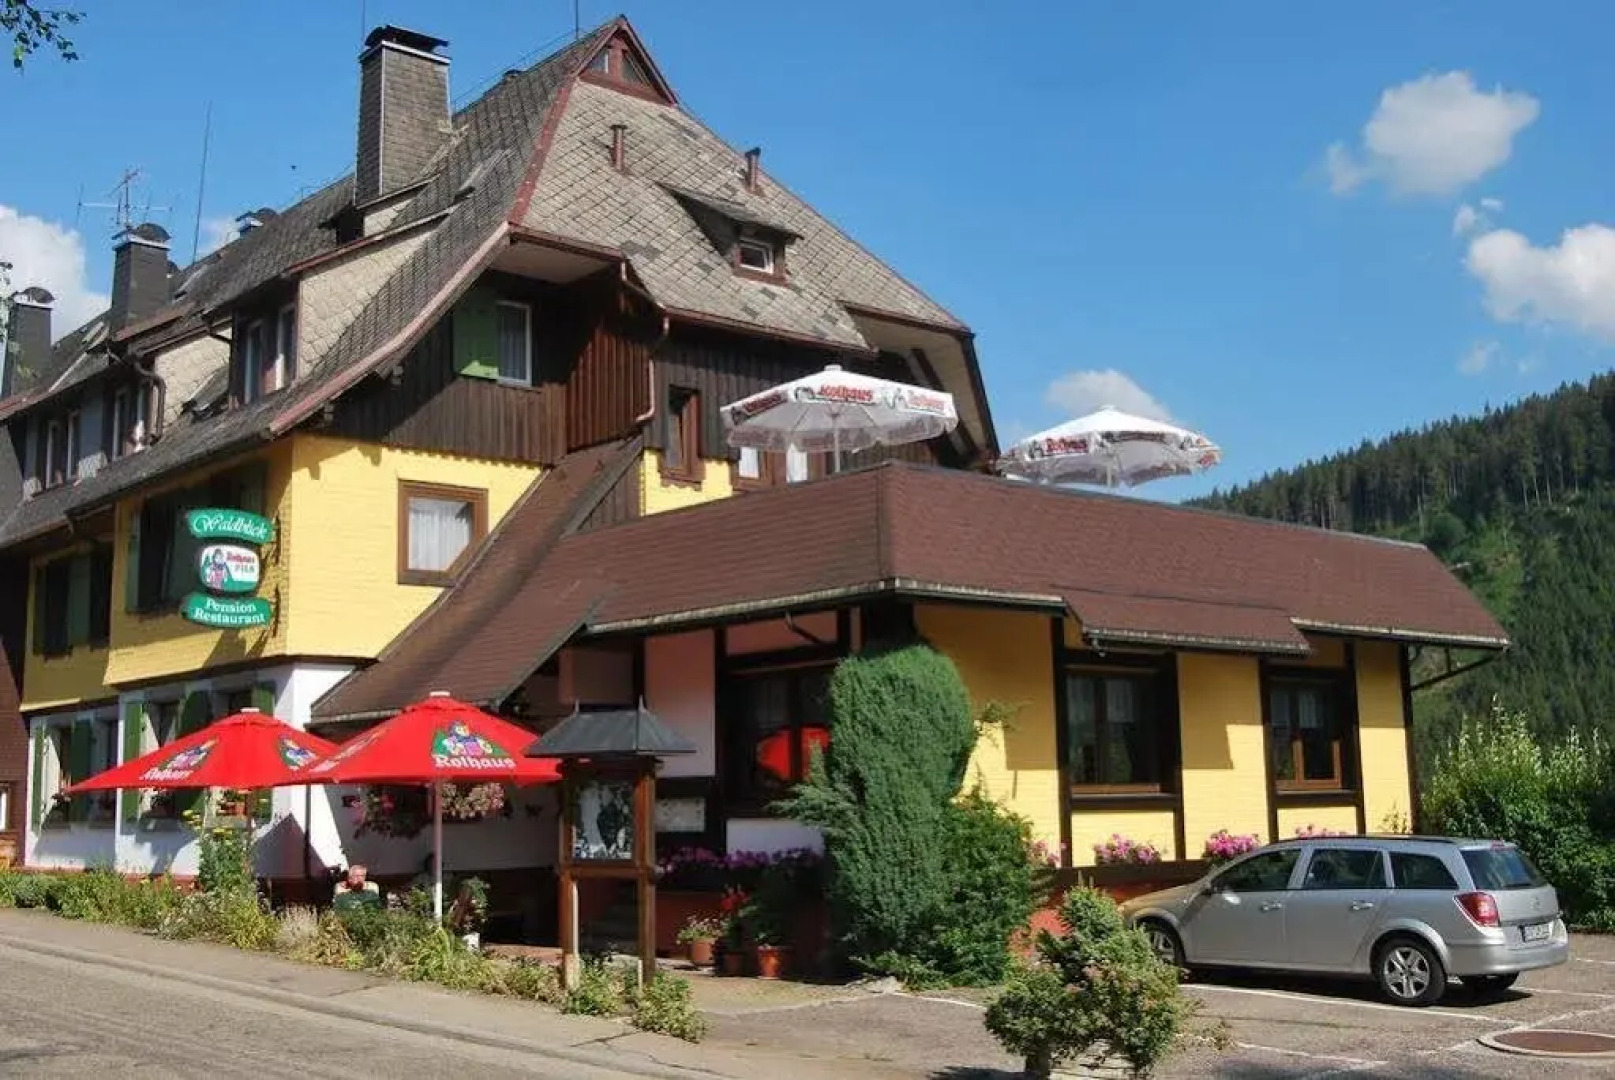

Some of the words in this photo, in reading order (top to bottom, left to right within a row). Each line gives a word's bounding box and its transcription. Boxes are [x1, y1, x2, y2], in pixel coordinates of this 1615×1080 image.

[193, 514, 268, 540] Waldblick
[206, 600, 257, 613] Pension
[194, 608, 266, 623] Restaurant
